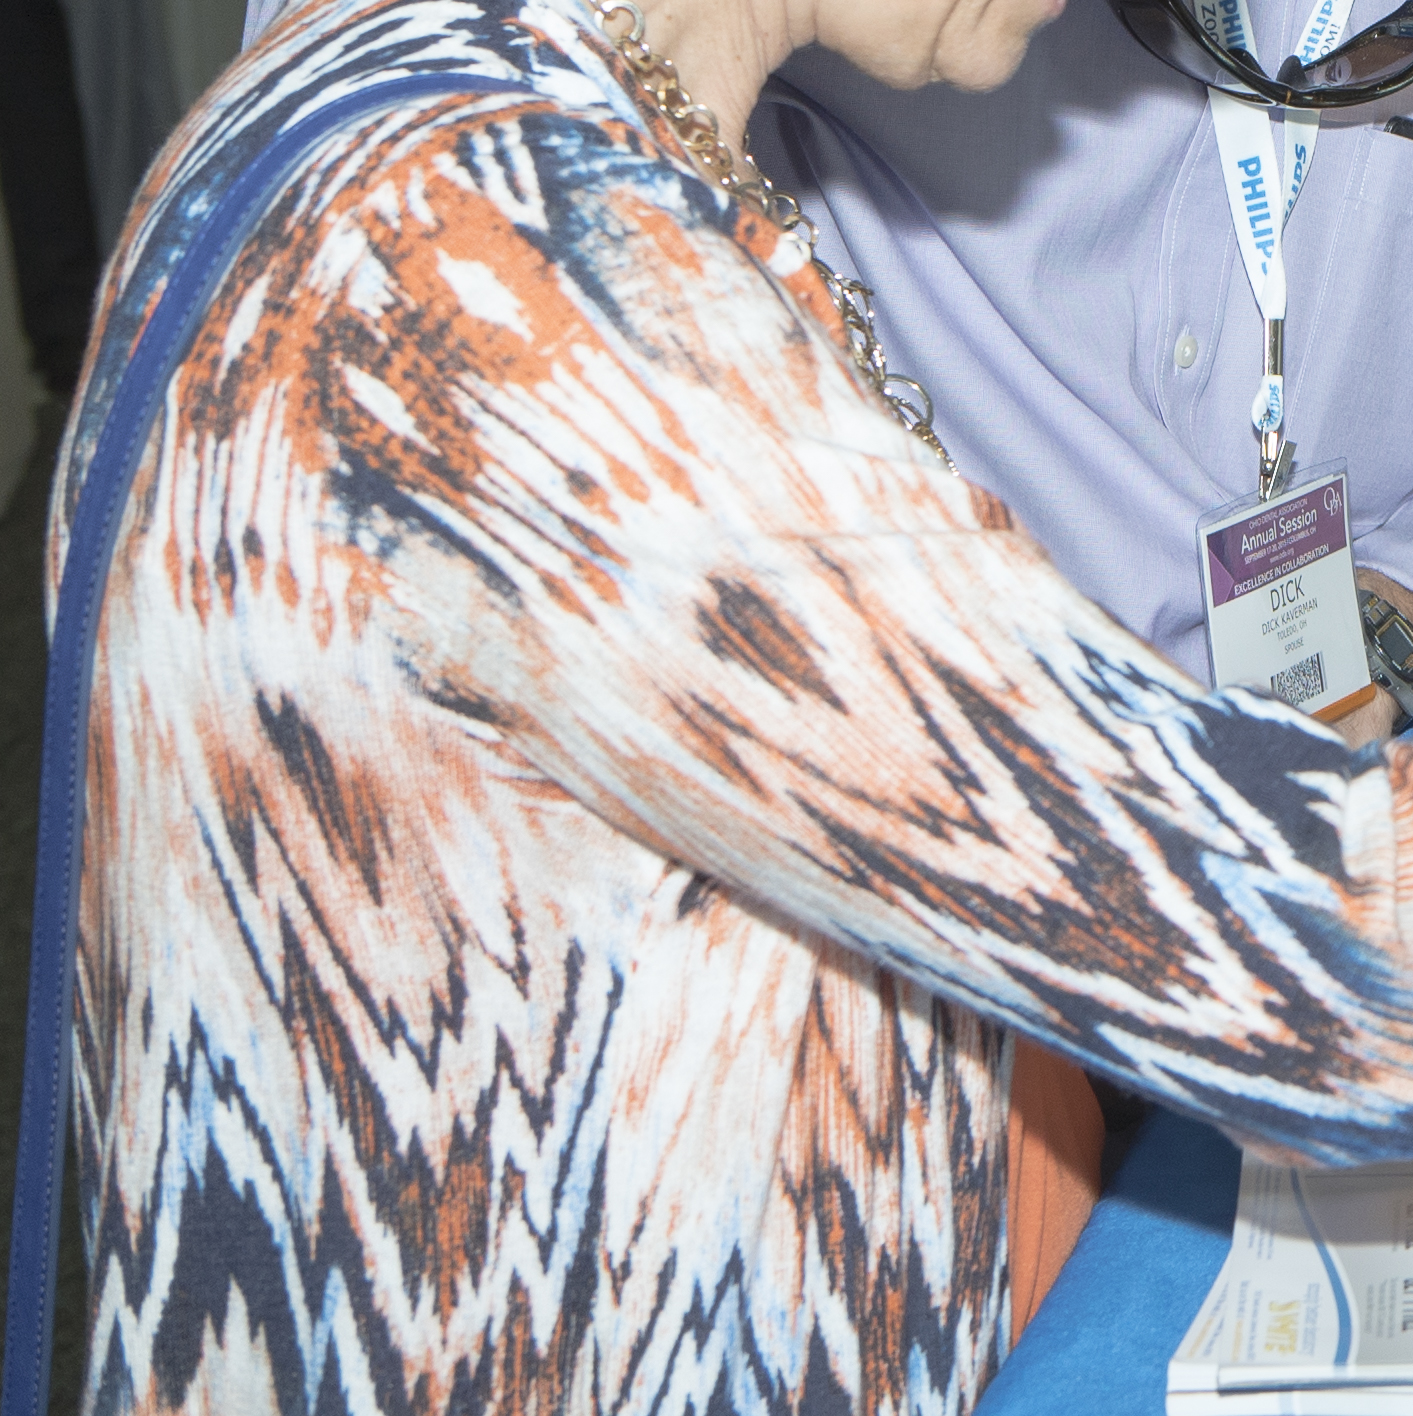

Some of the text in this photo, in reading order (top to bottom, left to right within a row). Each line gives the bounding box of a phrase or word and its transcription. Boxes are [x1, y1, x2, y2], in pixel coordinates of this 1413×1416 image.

[1241, 509, 1318, 554] Annual Session
[1234, 544, 1330, 597] EXCELLENCE IN COLLABORATION
[1270, 574, 1305, 612] DICK
[1262, 598, 1318, 636] DICK KAVERMAN
[1284, 636, 1305, 654] SPOUSE
